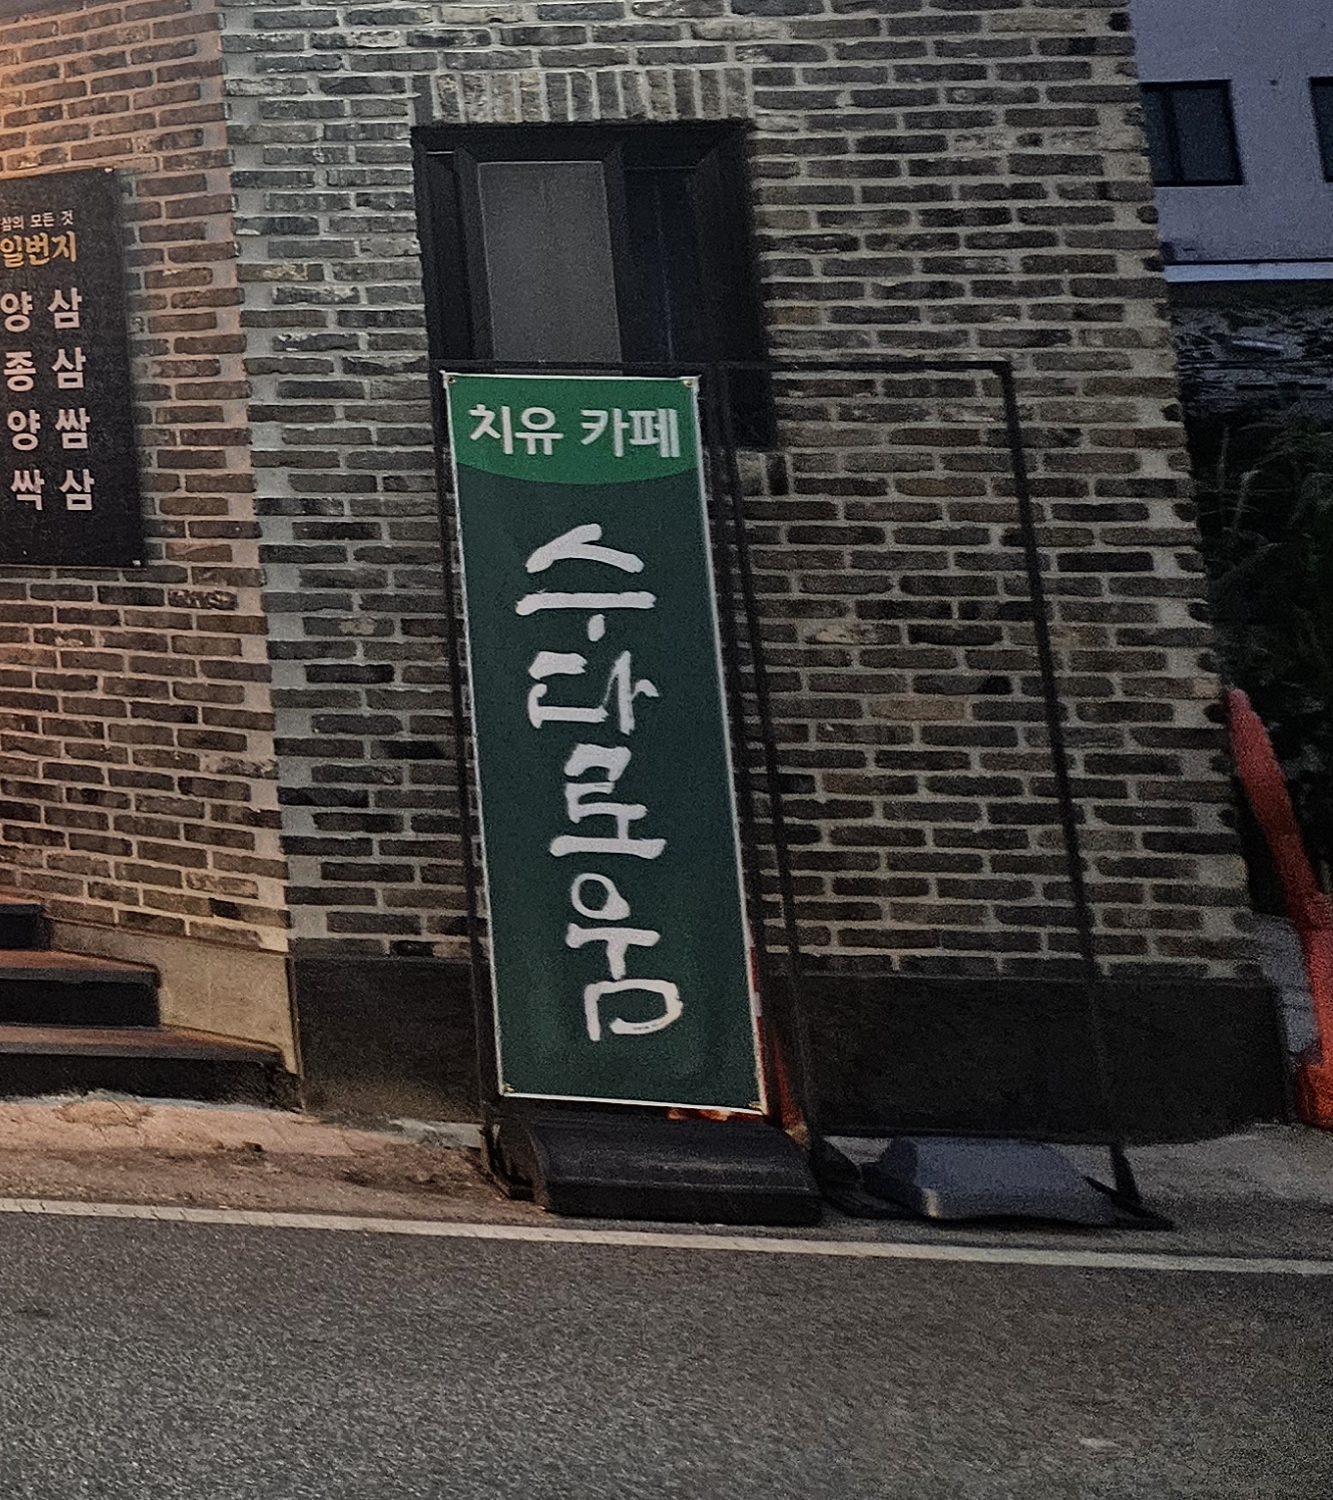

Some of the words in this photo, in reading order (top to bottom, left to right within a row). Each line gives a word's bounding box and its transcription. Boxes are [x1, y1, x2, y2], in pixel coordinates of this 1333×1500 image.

[30, 211, 55, 228] 모든
[61, 209, 74, 226] 것
[468, 403, 564, 457] 치유
[579, 405, 682, 459] 카페
[515, 522, 685, 1042] 수다로움
